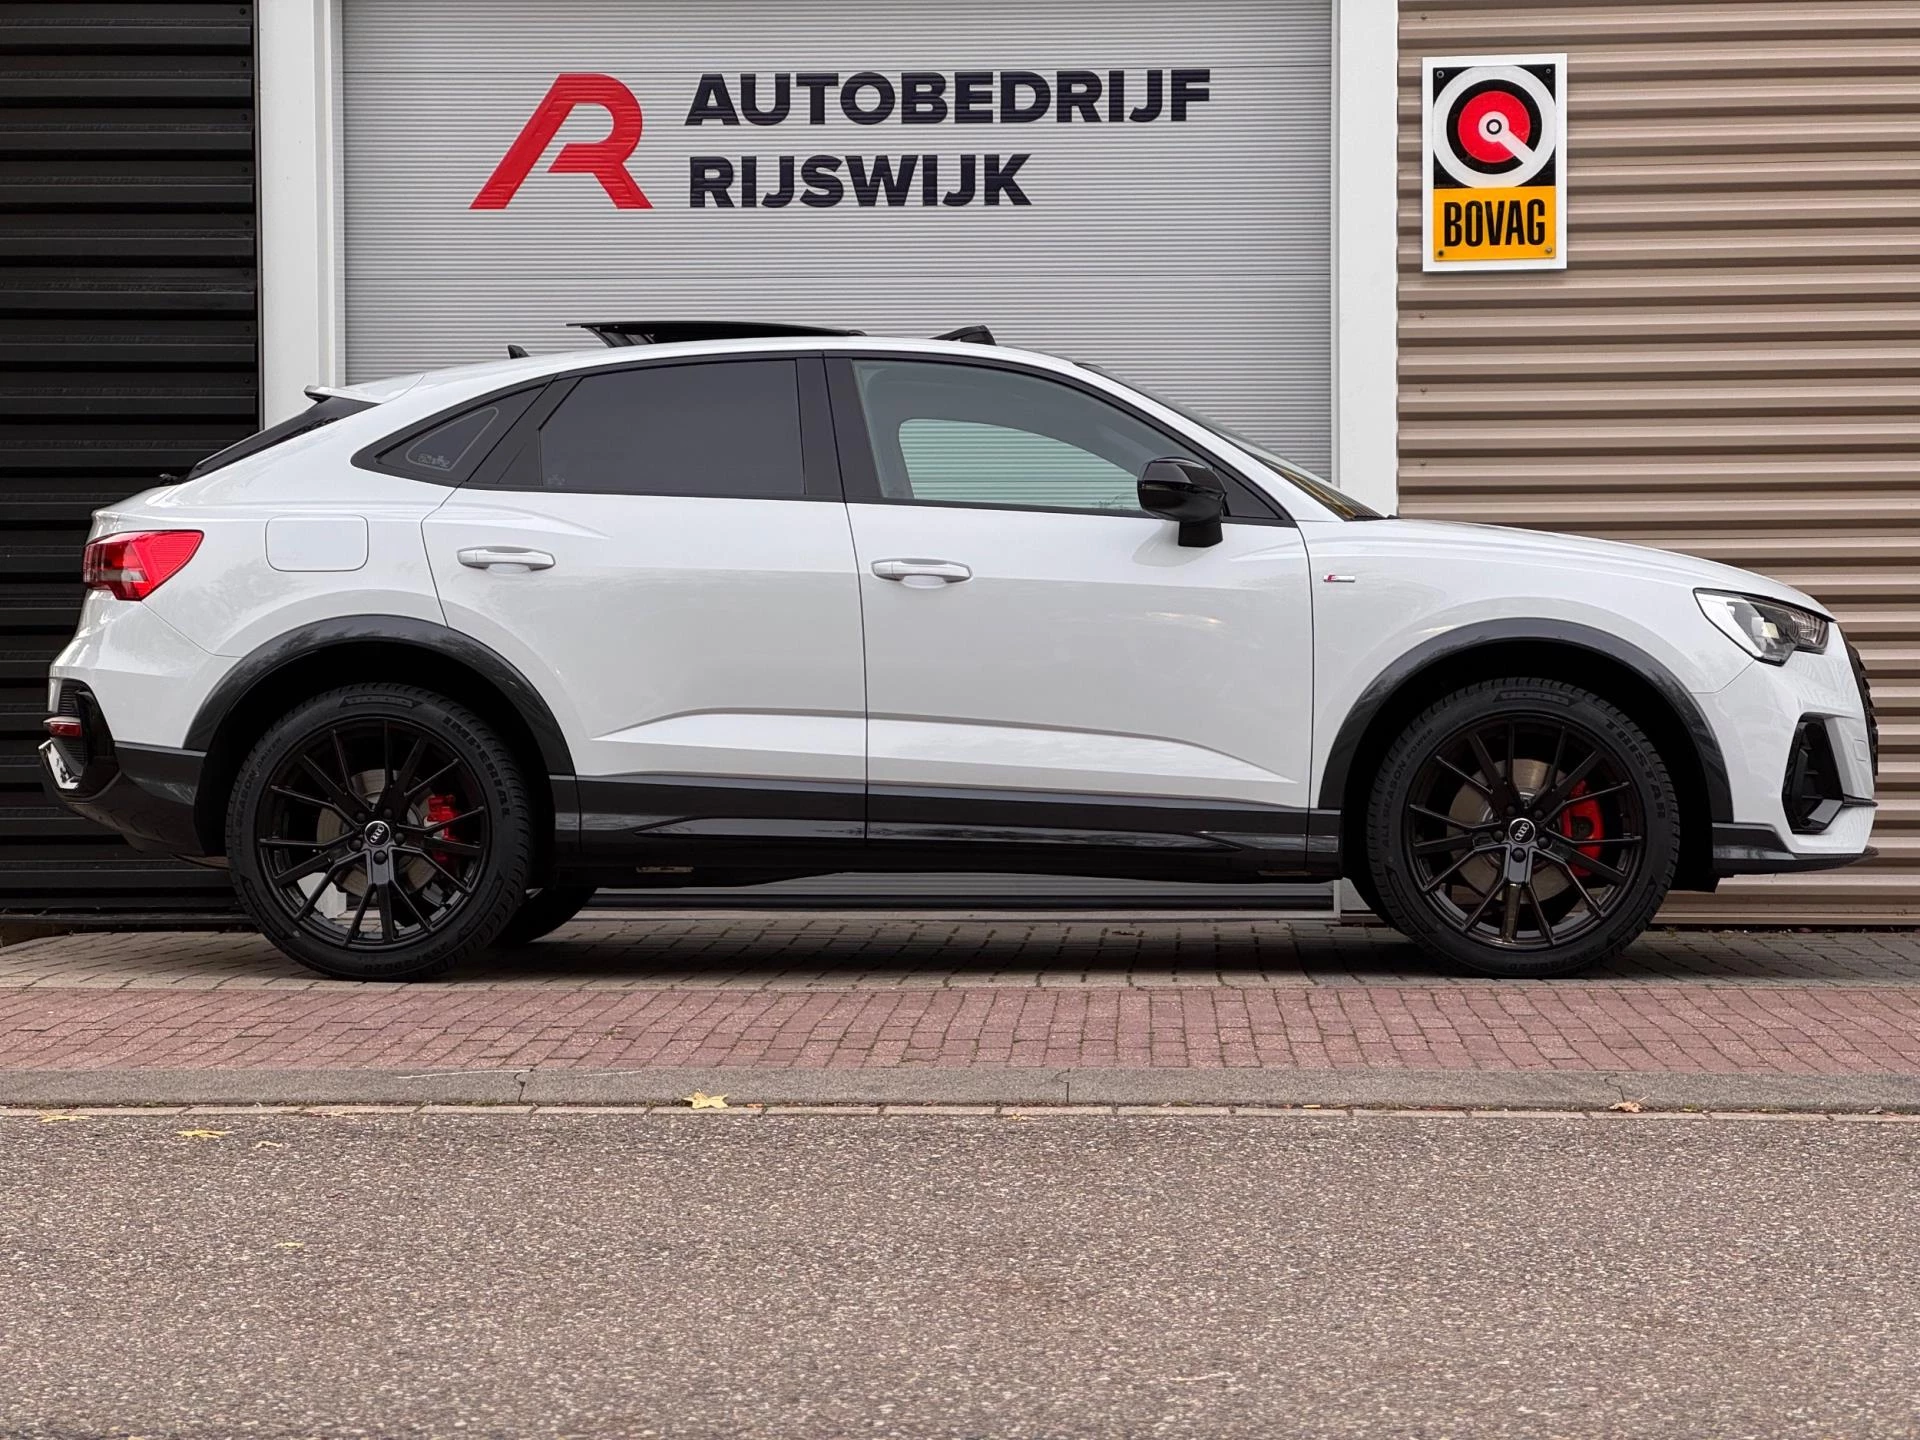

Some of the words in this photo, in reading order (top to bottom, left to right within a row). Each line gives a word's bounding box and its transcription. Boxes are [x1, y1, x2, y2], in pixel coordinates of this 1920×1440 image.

[684, 68, 1211, 126] AUTOBEDRIJF
[689, 153, 1033, 208] RIJSWIJK
[1444, 198, 1546, 247] BOVAG
[1603, 718, 1665, 818] TRISTAR
